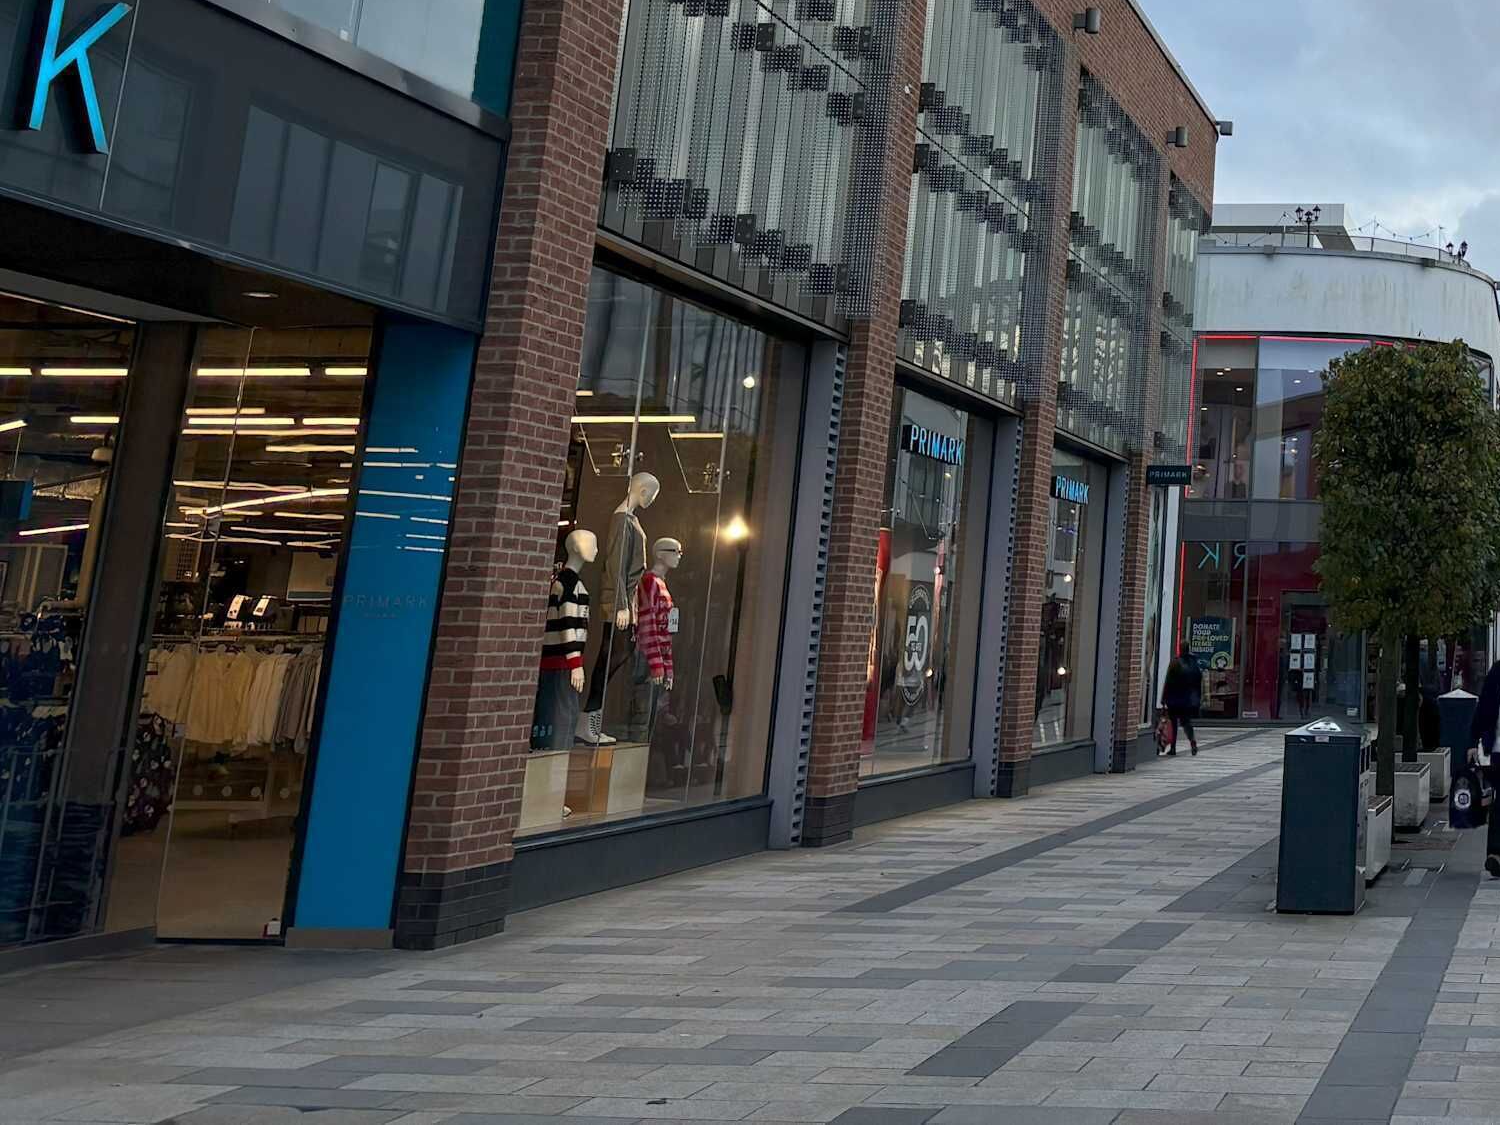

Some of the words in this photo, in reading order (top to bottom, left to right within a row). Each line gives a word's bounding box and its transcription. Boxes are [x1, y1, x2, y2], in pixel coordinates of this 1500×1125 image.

[909, 424, 964, 467] PRIMARK
[1054, 475, 1090, 505] PRIMARK
[1149, 470, 1188, 479] PRIMARK
[905, 615, 929, 672] 50
